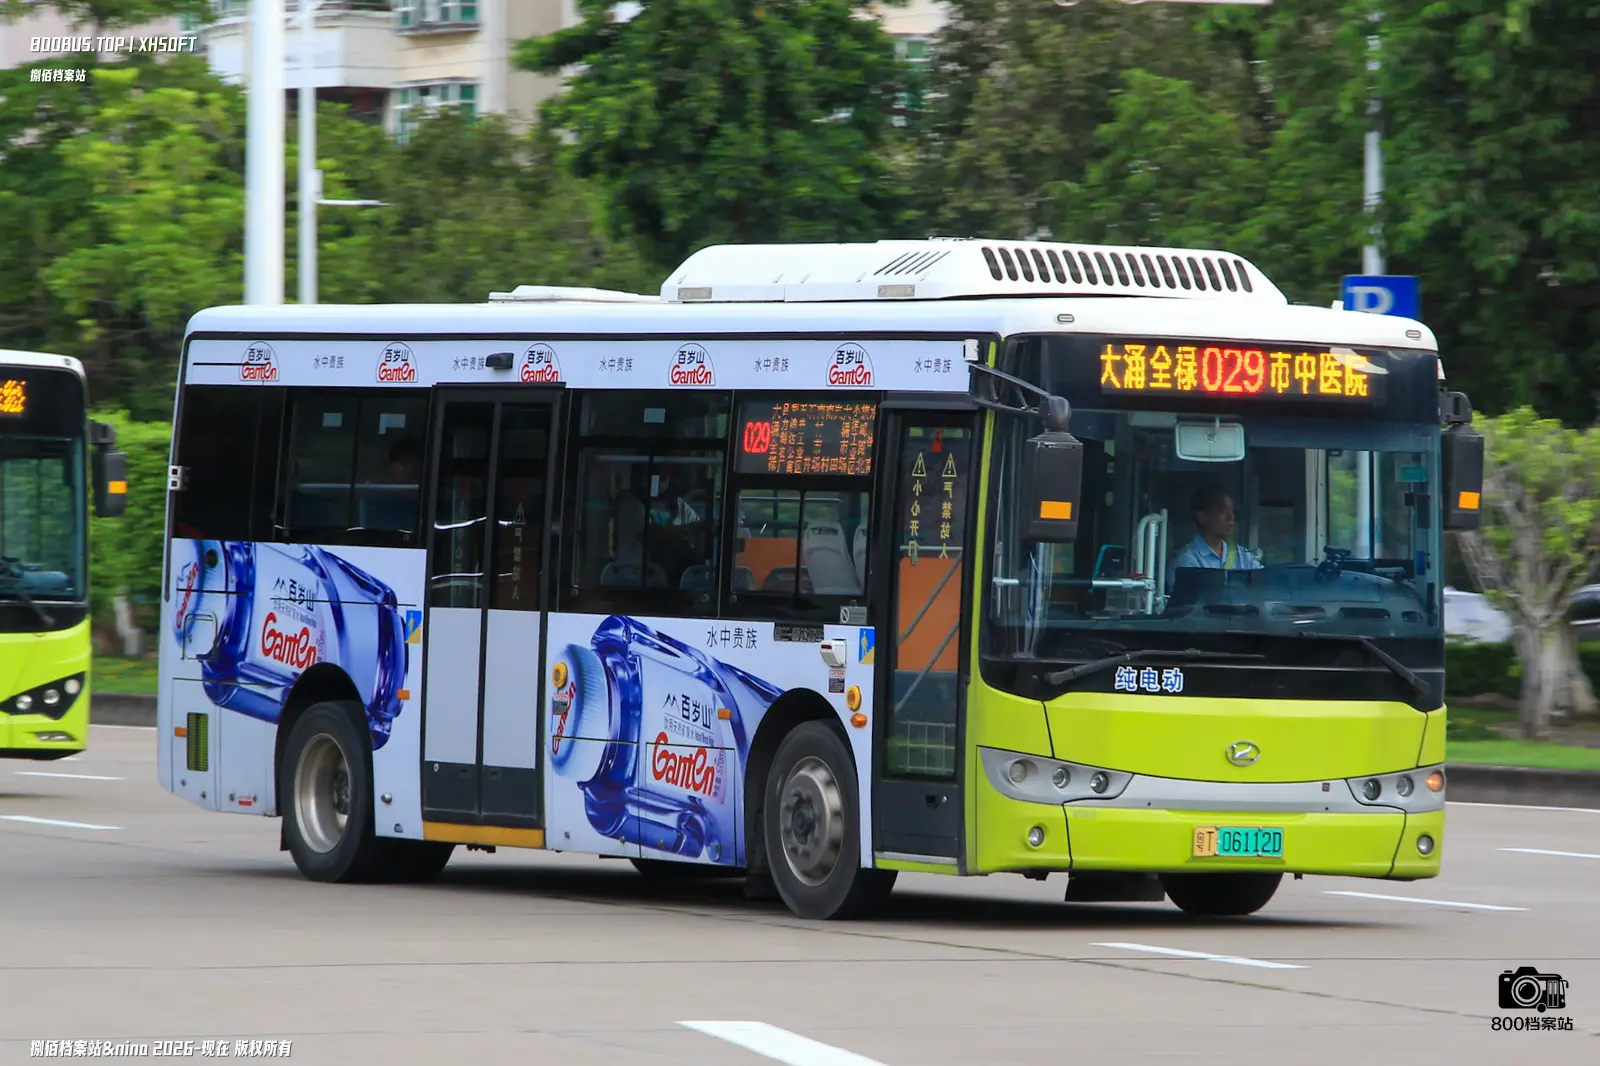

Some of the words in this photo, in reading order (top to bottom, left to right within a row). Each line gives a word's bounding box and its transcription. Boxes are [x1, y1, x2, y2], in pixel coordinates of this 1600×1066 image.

[248, 348, 272, 361] 百岁山
[313, 355, 345, 369] 水中贵族
[384, 348, 410, 363] 百岁山
[452, 356, 485, 371] 水中贵族
[528, 350, 552, 364] 百岁山
[678, 350, 705, 364] 百岁山
[836, 350, 864, 365] 百岁山
[378, 362, 415, 382] Ganten
[521, 363, 559, 382] Ganten
[599, 357, 634, 372] 水中贵族
[670, 363, 712, 385] Ganten
[753, 357, 790, 372] 水中贵族
[914, 357, 952, 374] 水中贵族
[1100, 343, 1198, 391] 大涌全禄
[1202, 347, 1265, 393] 029
[1270, 351, 1369, 396] 市中医院
[829, 364, 871, 386] Ganten
[744, 421, 771, 453] 029
[288, 577, 315, 613] 百岁山
[261, 611, 317, 669] Ganten
[706, 625, 758, 649] 水中贵族
[1115, 666, 1184, 693] 纯电动
[681, 693, 711, 730] 百岁山
[652, 731, 715, 797] Ganten
